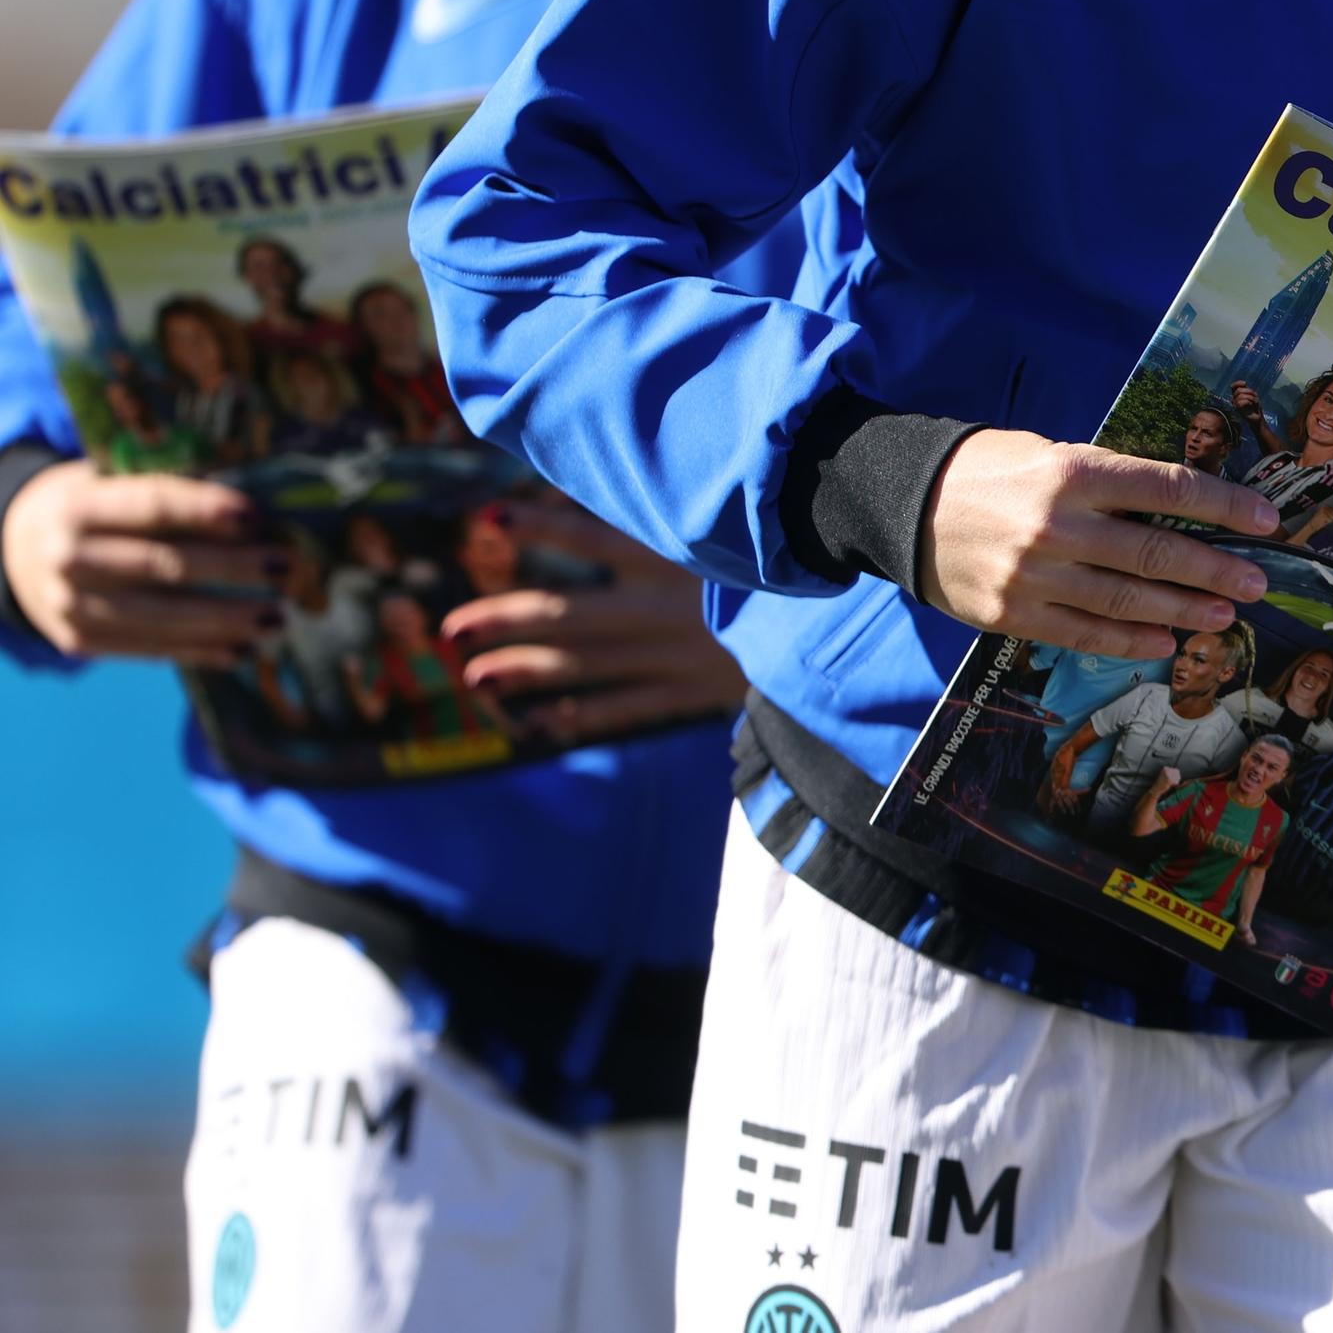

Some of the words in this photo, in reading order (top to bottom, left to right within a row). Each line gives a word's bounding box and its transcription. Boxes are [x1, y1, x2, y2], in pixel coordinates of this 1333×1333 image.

[0, 134, 408, 223] Calciatrici
[914, 791, 930, 806] LE
[922, 752, 954, 793] GRANDI
[944, 704, 982, 754] RACCOLTE
[973, 683, 993, 708] PER
[985, 668, 1000, 685] LA
[1141, 887, 1229, 939] PANINI
[829, 1139, 1022, 1252] TIM
